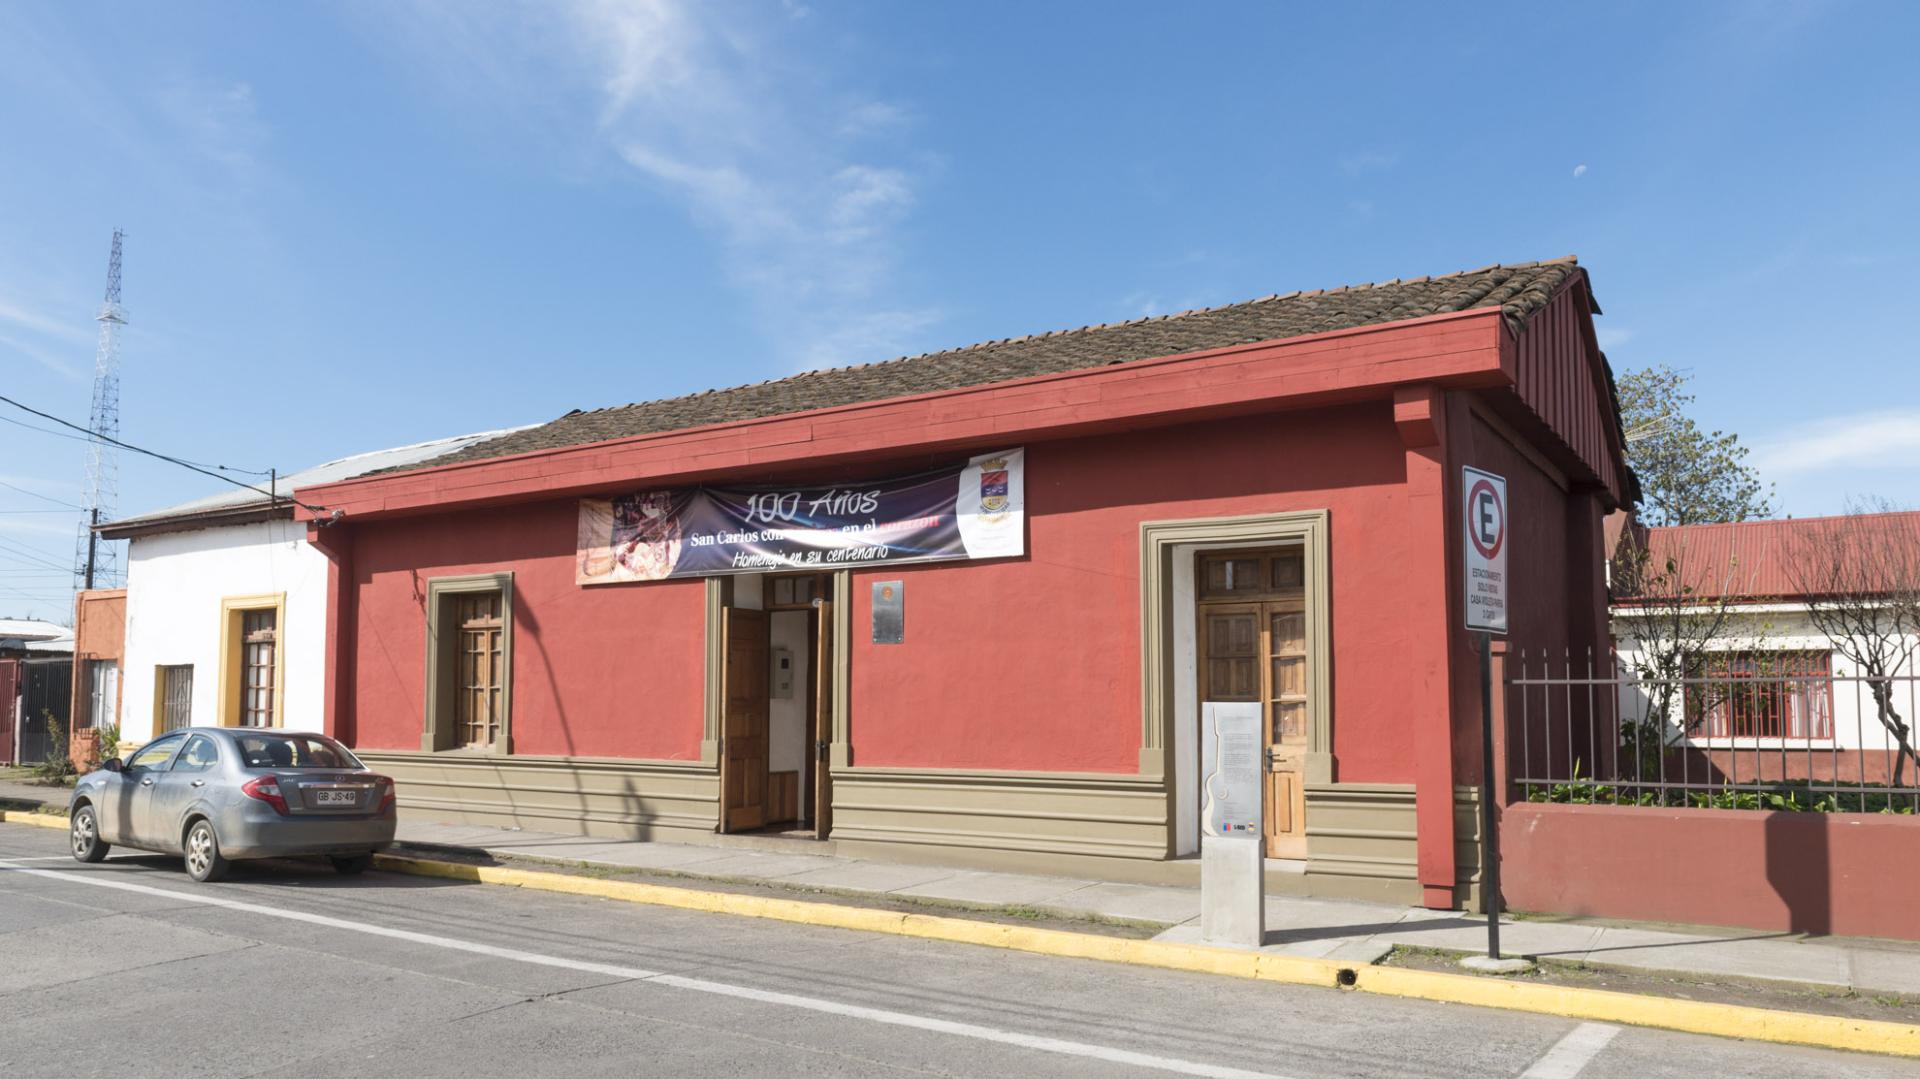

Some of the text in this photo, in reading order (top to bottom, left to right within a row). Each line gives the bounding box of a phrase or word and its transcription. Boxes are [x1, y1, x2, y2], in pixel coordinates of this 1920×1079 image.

[745, 488, 881, 523] 100 Años
[1480, 493, 1495, 544] E
[690, 532, 714, 547] San
[717, 528, 758, 545] Carlos
[863, 518, 876, 533] el
[732, 543, 888, 569] Homenaje en su centenario
